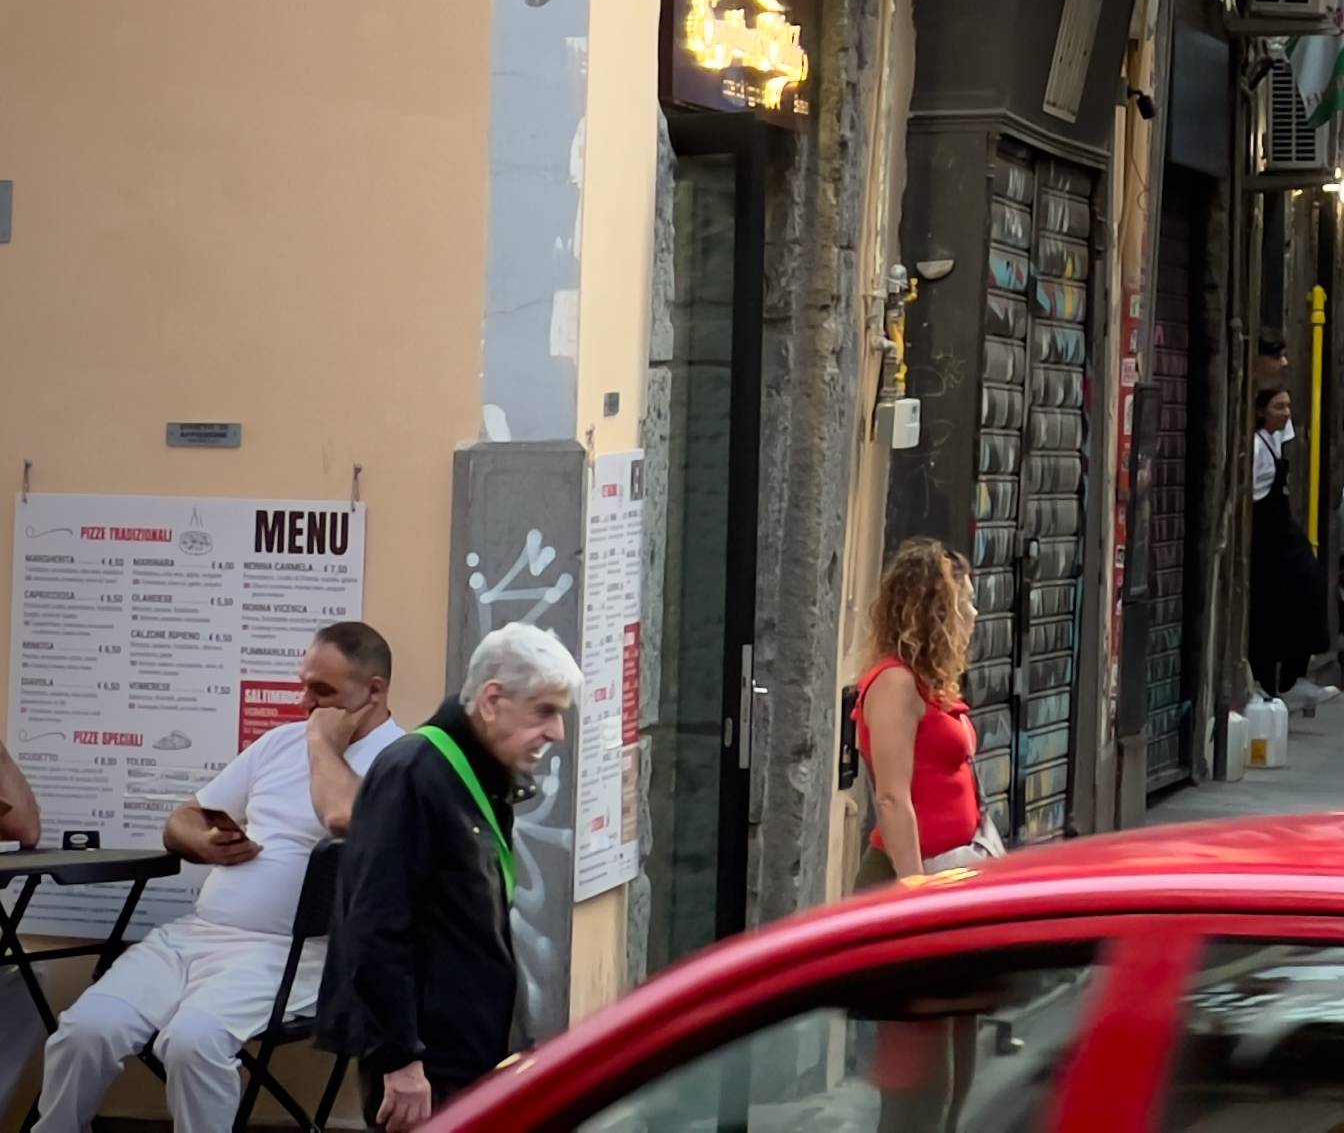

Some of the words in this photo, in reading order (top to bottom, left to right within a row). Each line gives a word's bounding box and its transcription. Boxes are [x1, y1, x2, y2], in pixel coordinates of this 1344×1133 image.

[80, 526, 106, 541] PIZZE
[109, 527, 172, 542] TRADIZIONALI
[255, 510, 349, 556] MENU
[130, 630, 166, 640] CALZONE
[73, 730, 98, 745] PIZZE
[101, 732, 143, 747] SPECIALI
